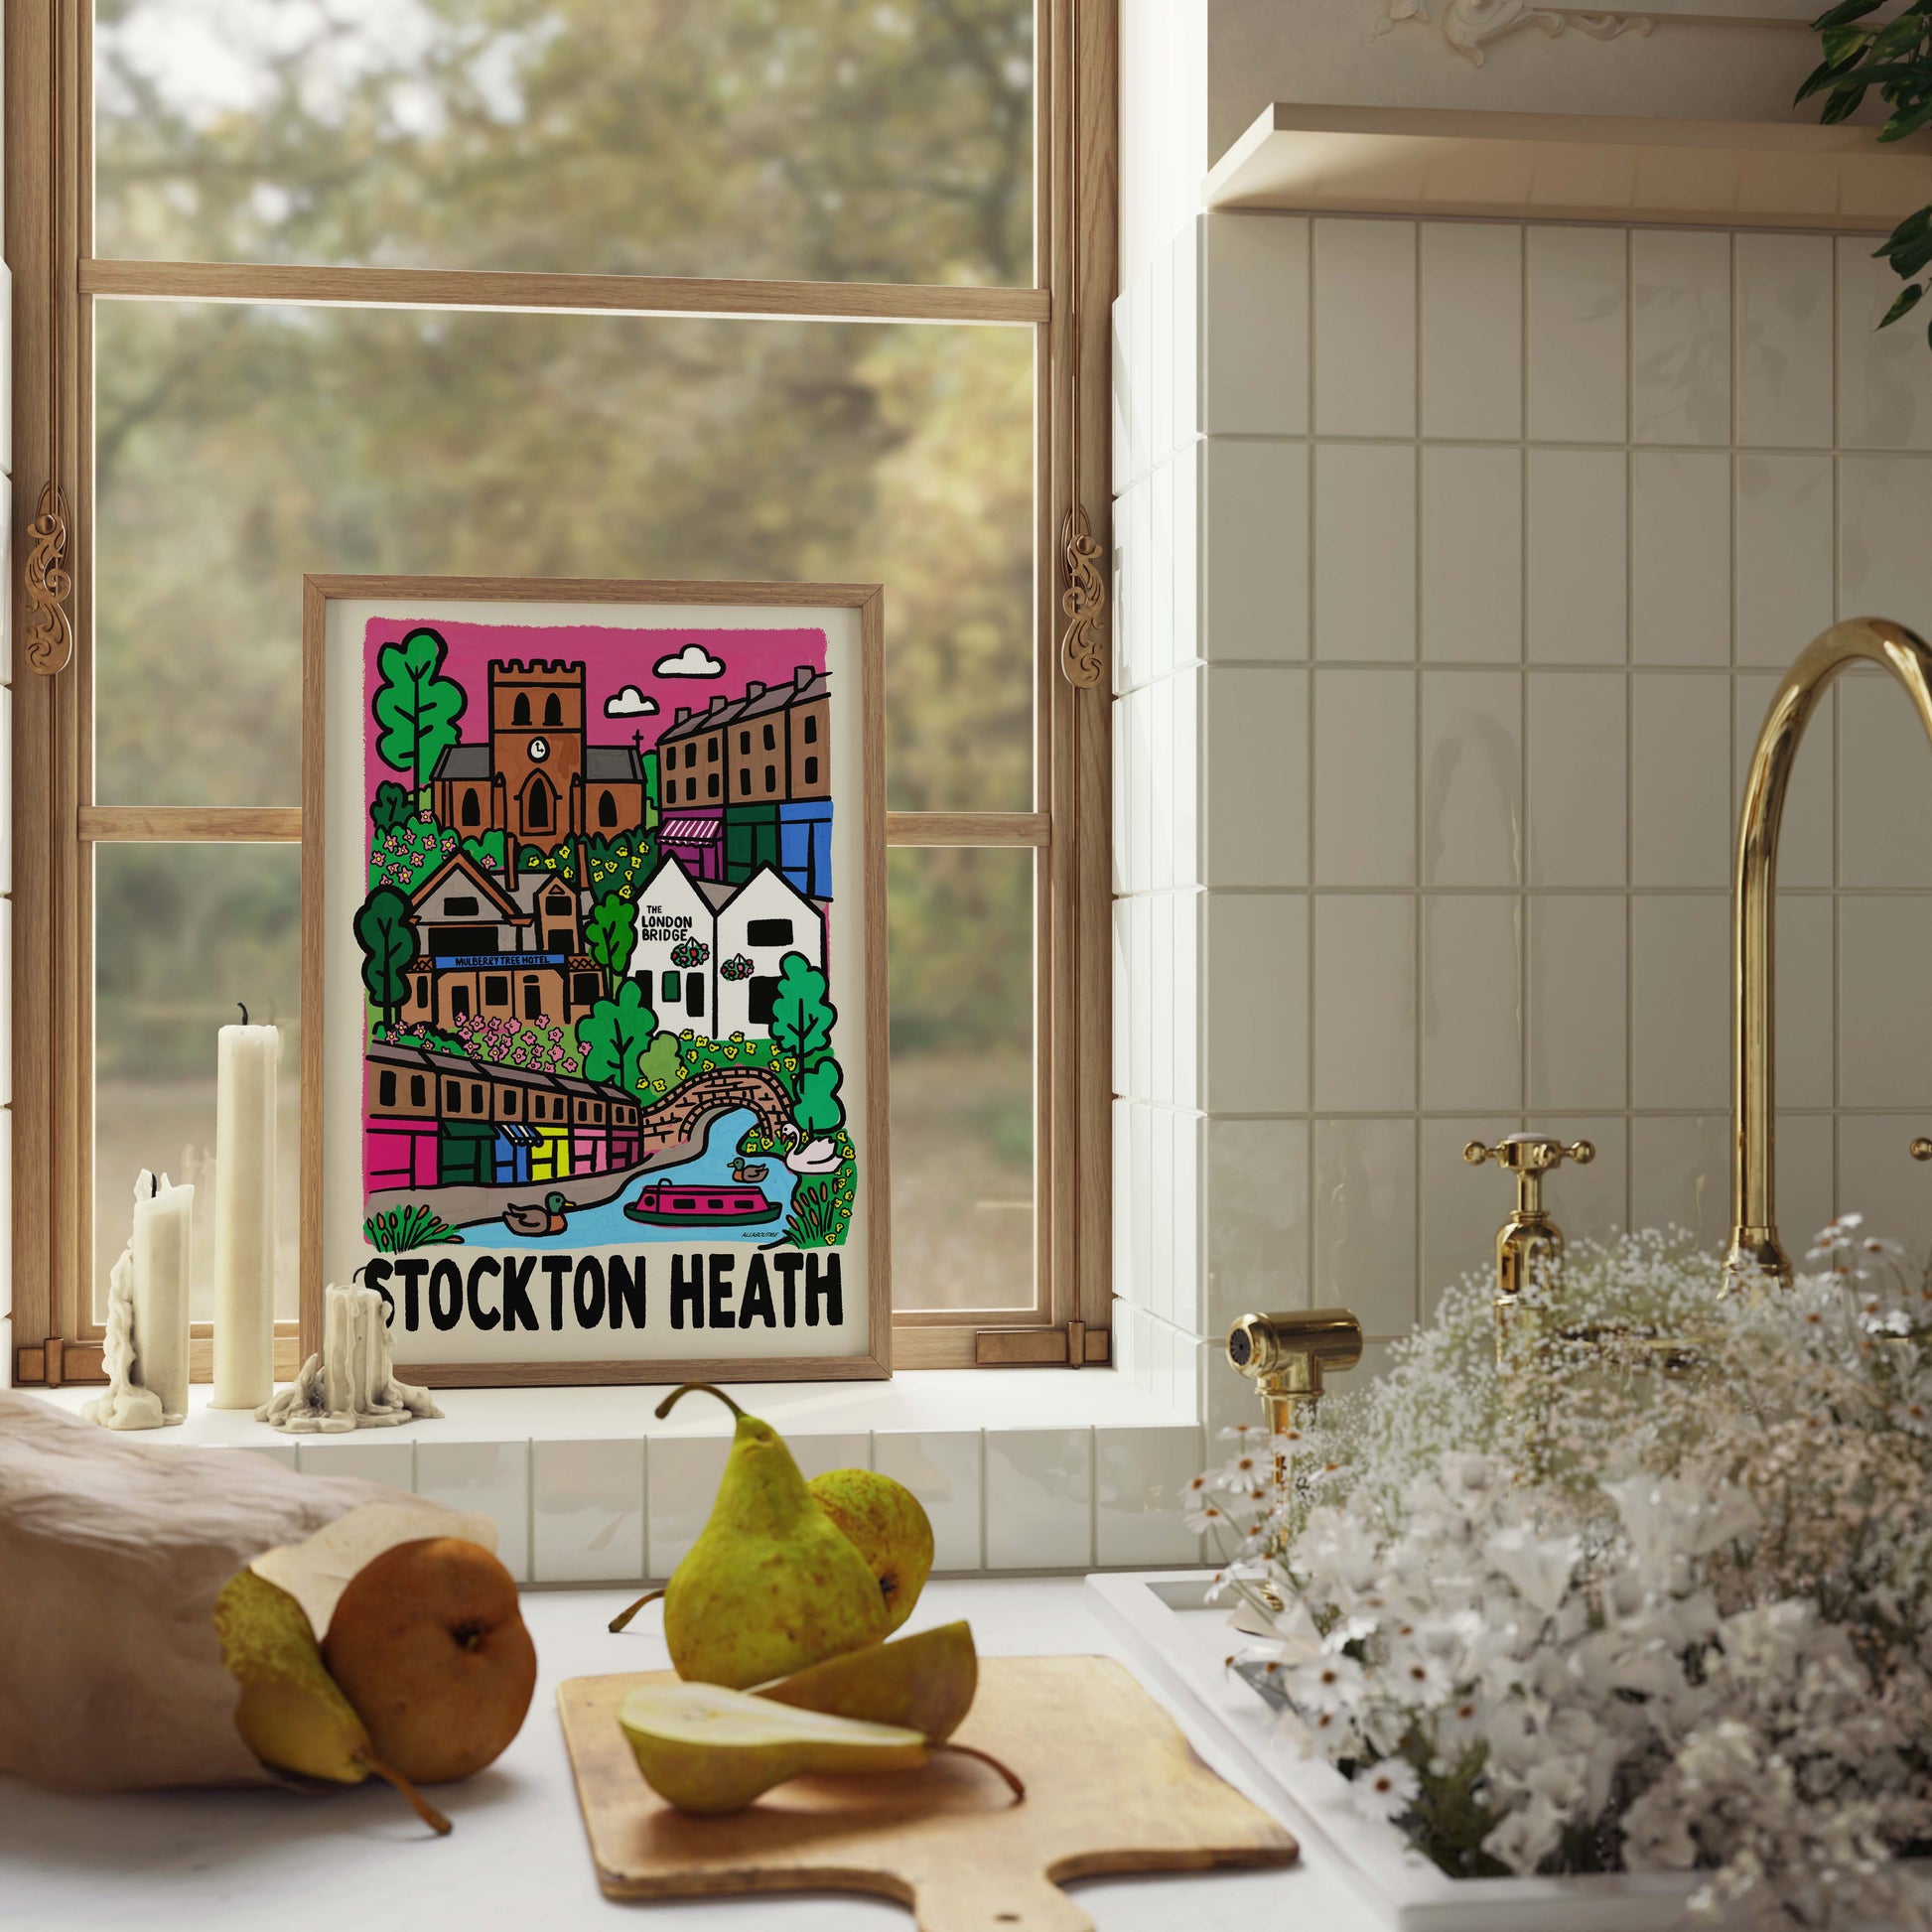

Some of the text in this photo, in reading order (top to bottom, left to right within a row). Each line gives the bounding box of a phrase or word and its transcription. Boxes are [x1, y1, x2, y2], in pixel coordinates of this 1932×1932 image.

[641, 915, 693, 928] LONDON
[641, 928, 688, 941] BRIDGE
[455, 955, 550, 967] MULBERRY TREE HOTEL
[364, 1252, 844, 1331] STOCKTON HEATH
